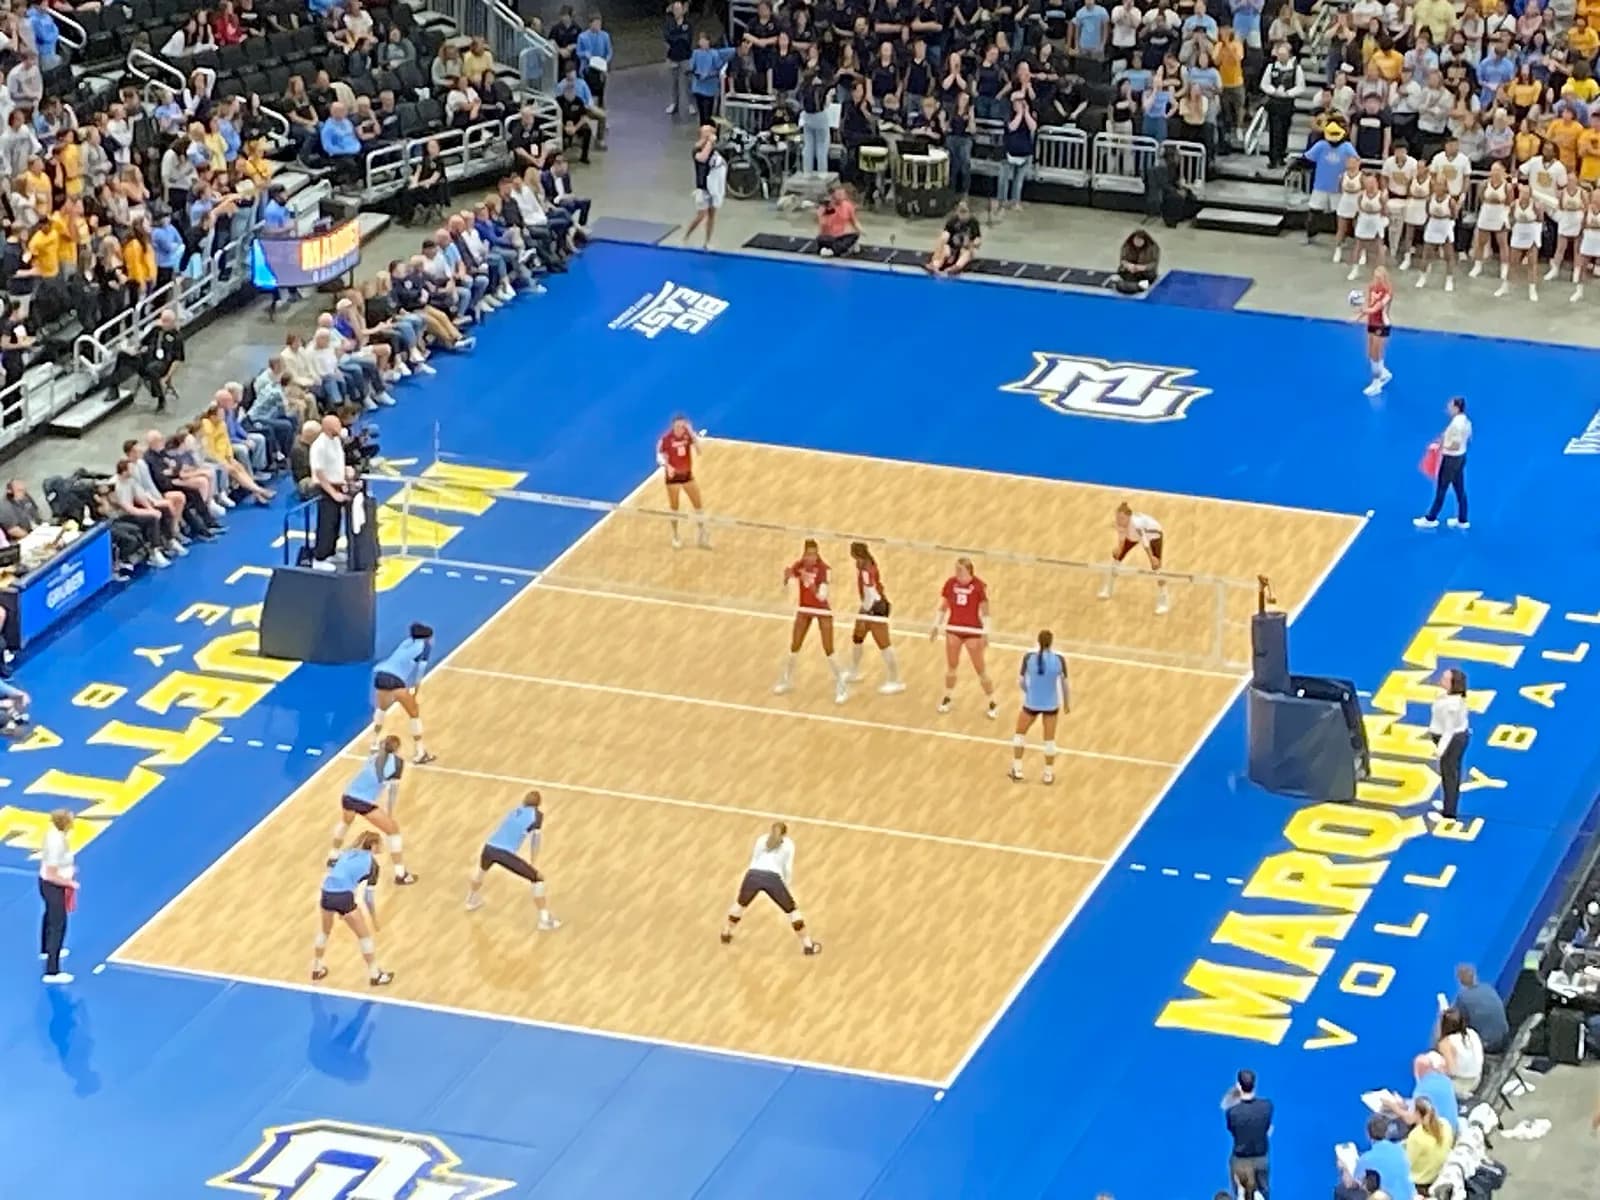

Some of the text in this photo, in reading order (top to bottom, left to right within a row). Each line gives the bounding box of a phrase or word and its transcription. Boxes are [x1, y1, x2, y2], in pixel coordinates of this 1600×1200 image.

[631, 285, 703, 339] EAST
[672, 294, 730, 335] BIG
[998, 352, 1214, 423] MU
[1155, 590, 1551, 1046] MARQUETTE
